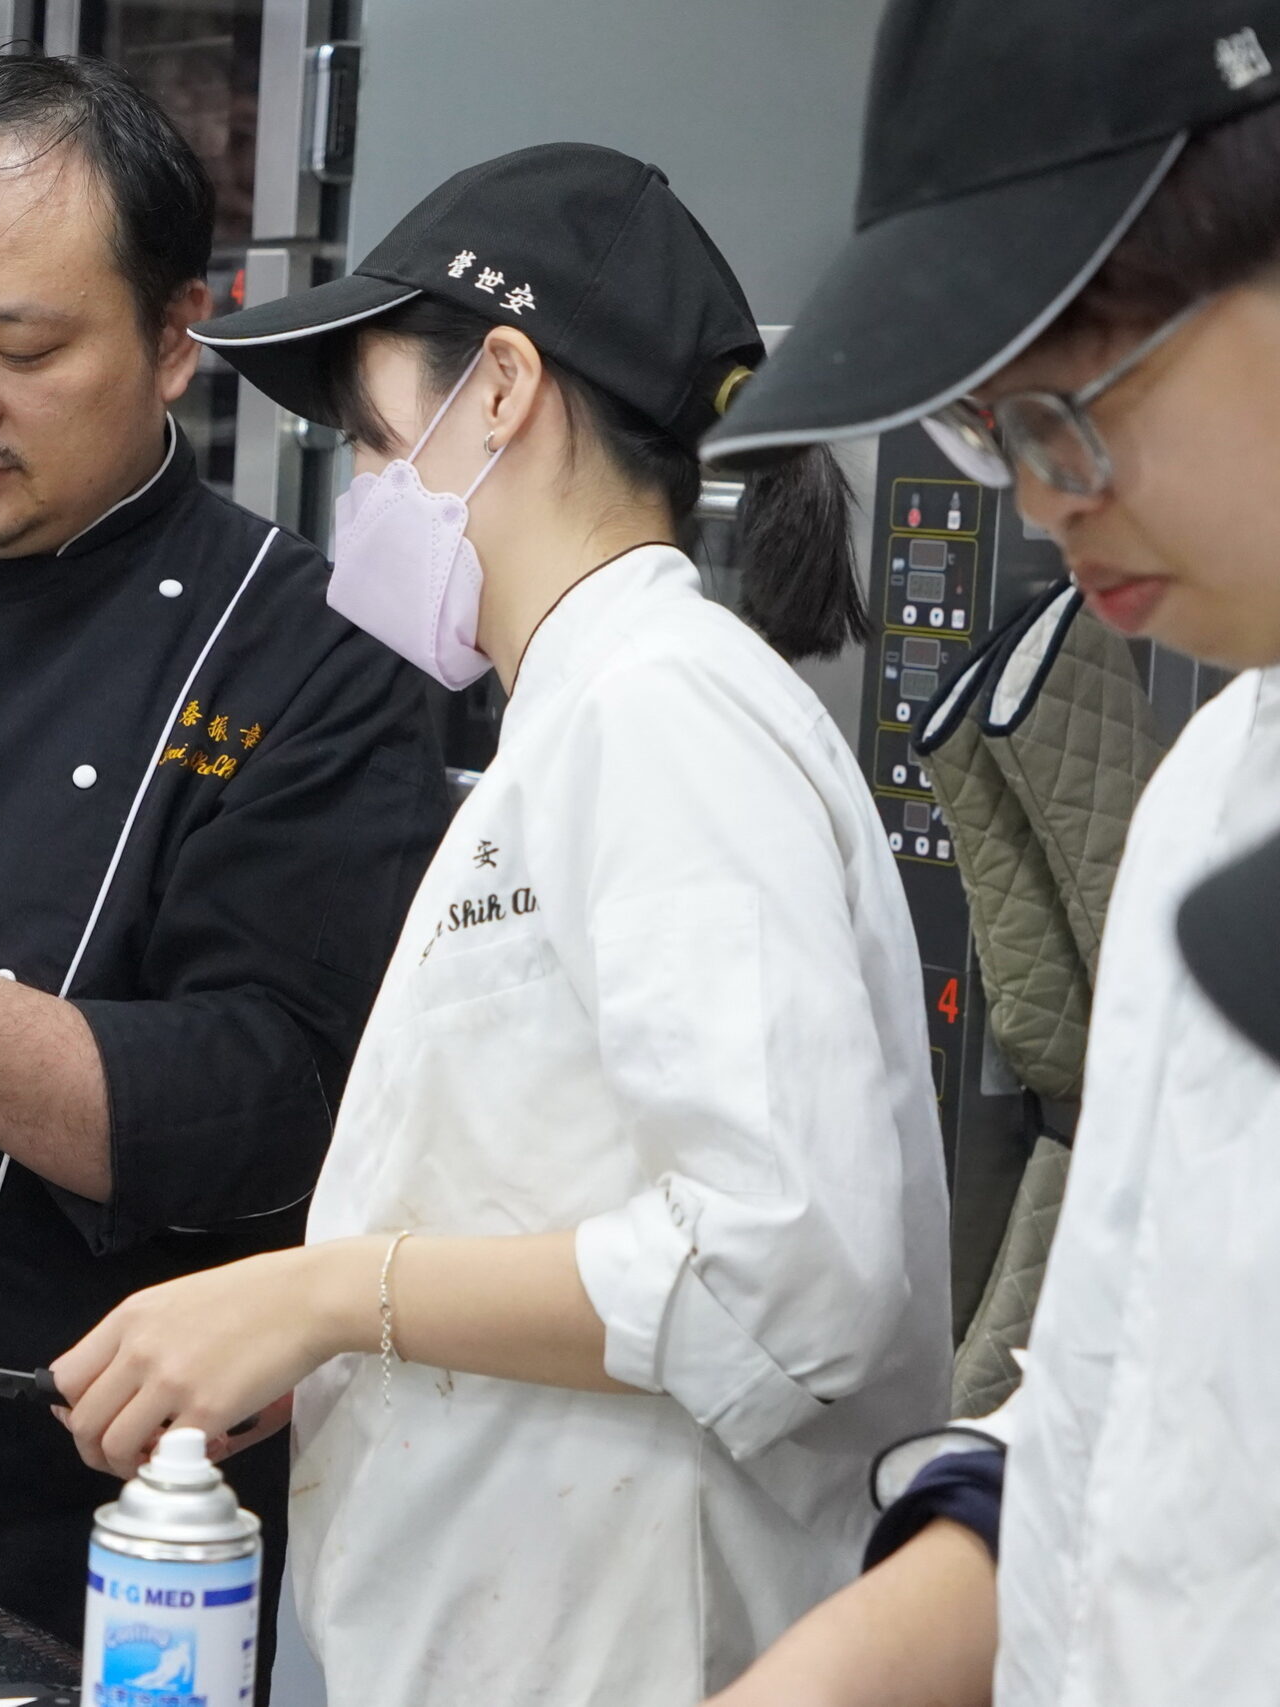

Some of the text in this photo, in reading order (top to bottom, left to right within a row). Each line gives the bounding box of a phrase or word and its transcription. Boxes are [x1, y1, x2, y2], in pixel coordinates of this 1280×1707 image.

[472, 839, 500, 869] 安
[448, 893, 507, 932] Shih
[937, 977, 959, 1025] 4
[144, 1588, 196, 1608] MED
